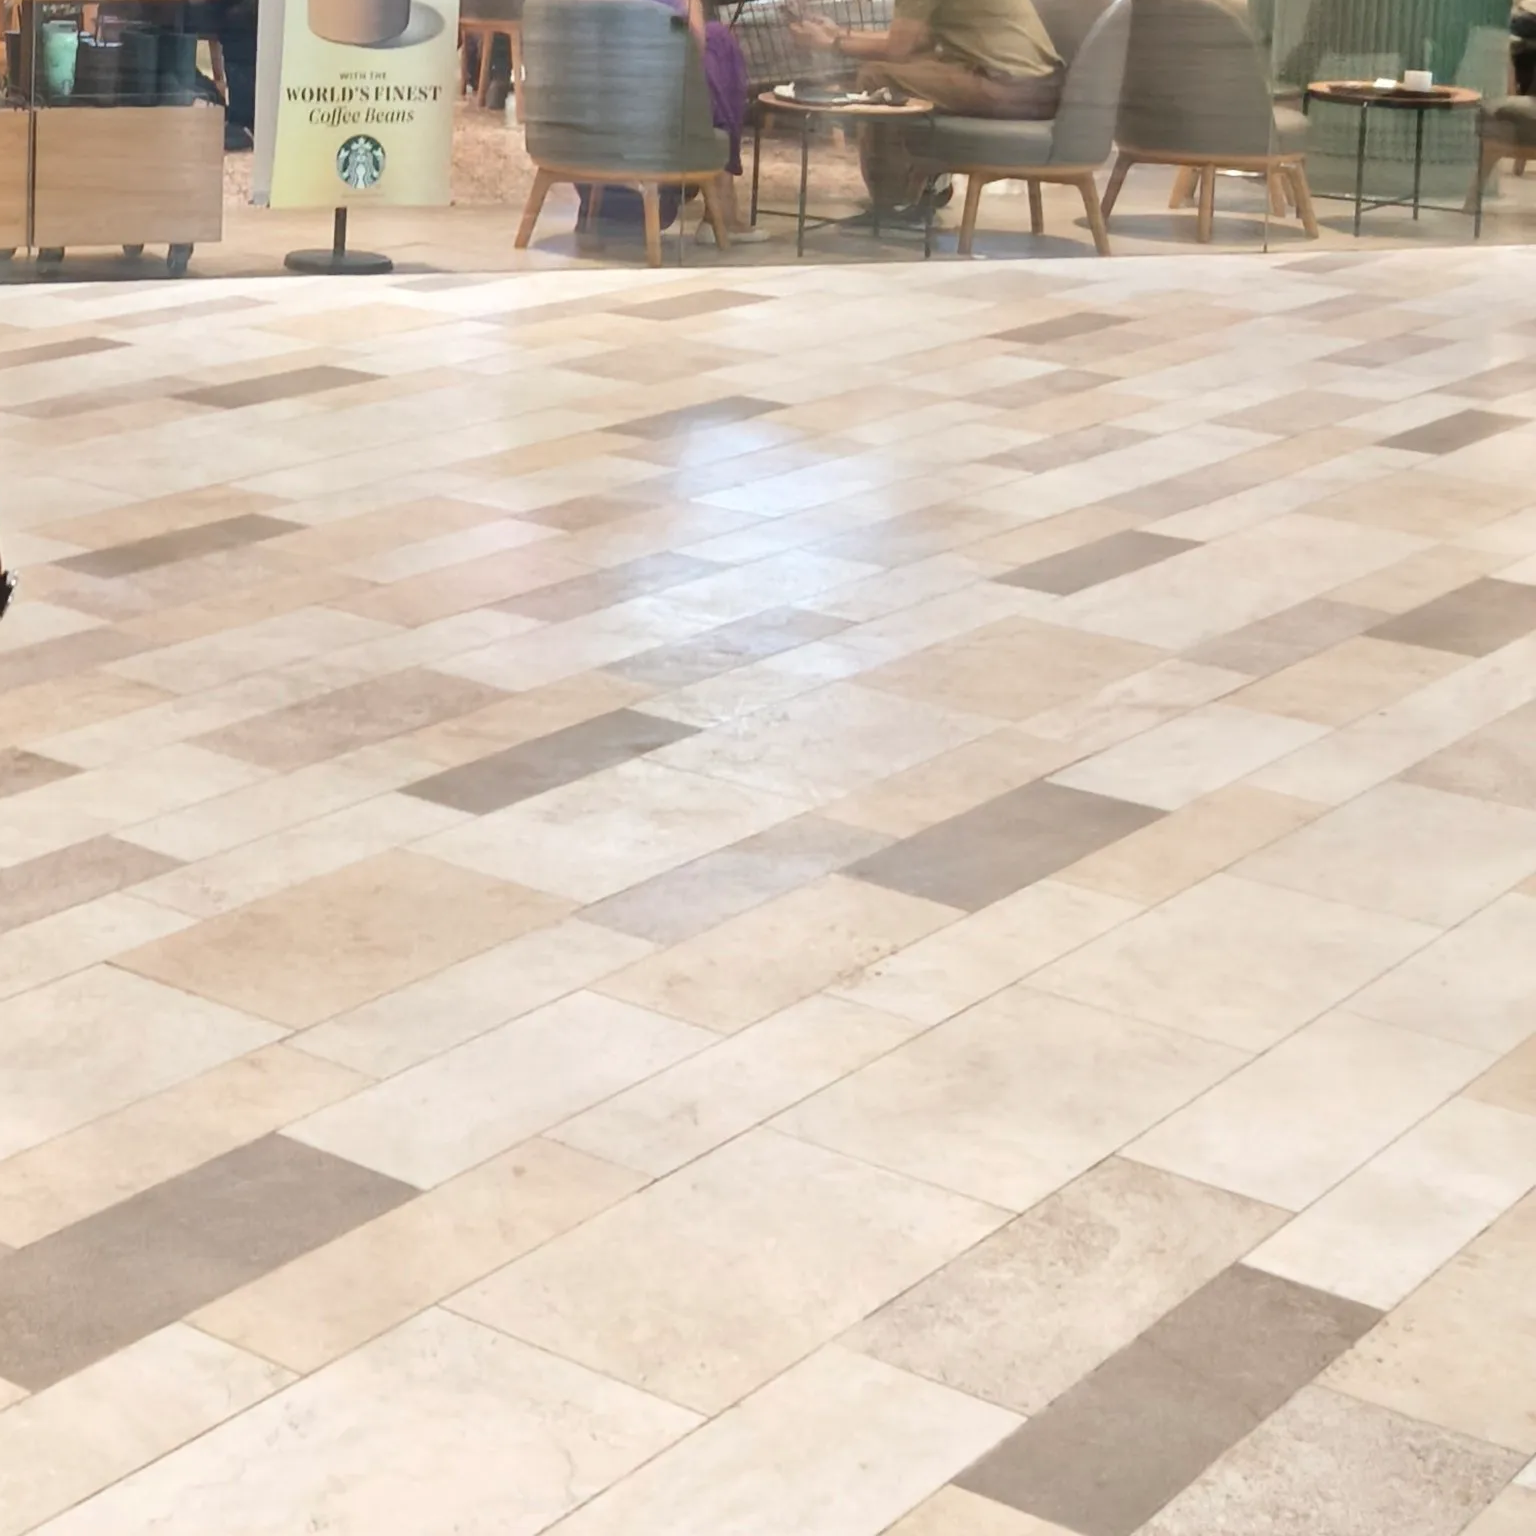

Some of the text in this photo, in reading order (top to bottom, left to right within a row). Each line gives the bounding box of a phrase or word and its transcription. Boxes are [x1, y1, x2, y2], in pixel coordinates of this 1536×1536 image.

[339, 71, 387, 81] WITH THE
[286, 84, 442, 103] WORLD'S FINEST
[308, 106, 415, 128] Coffee Beans
